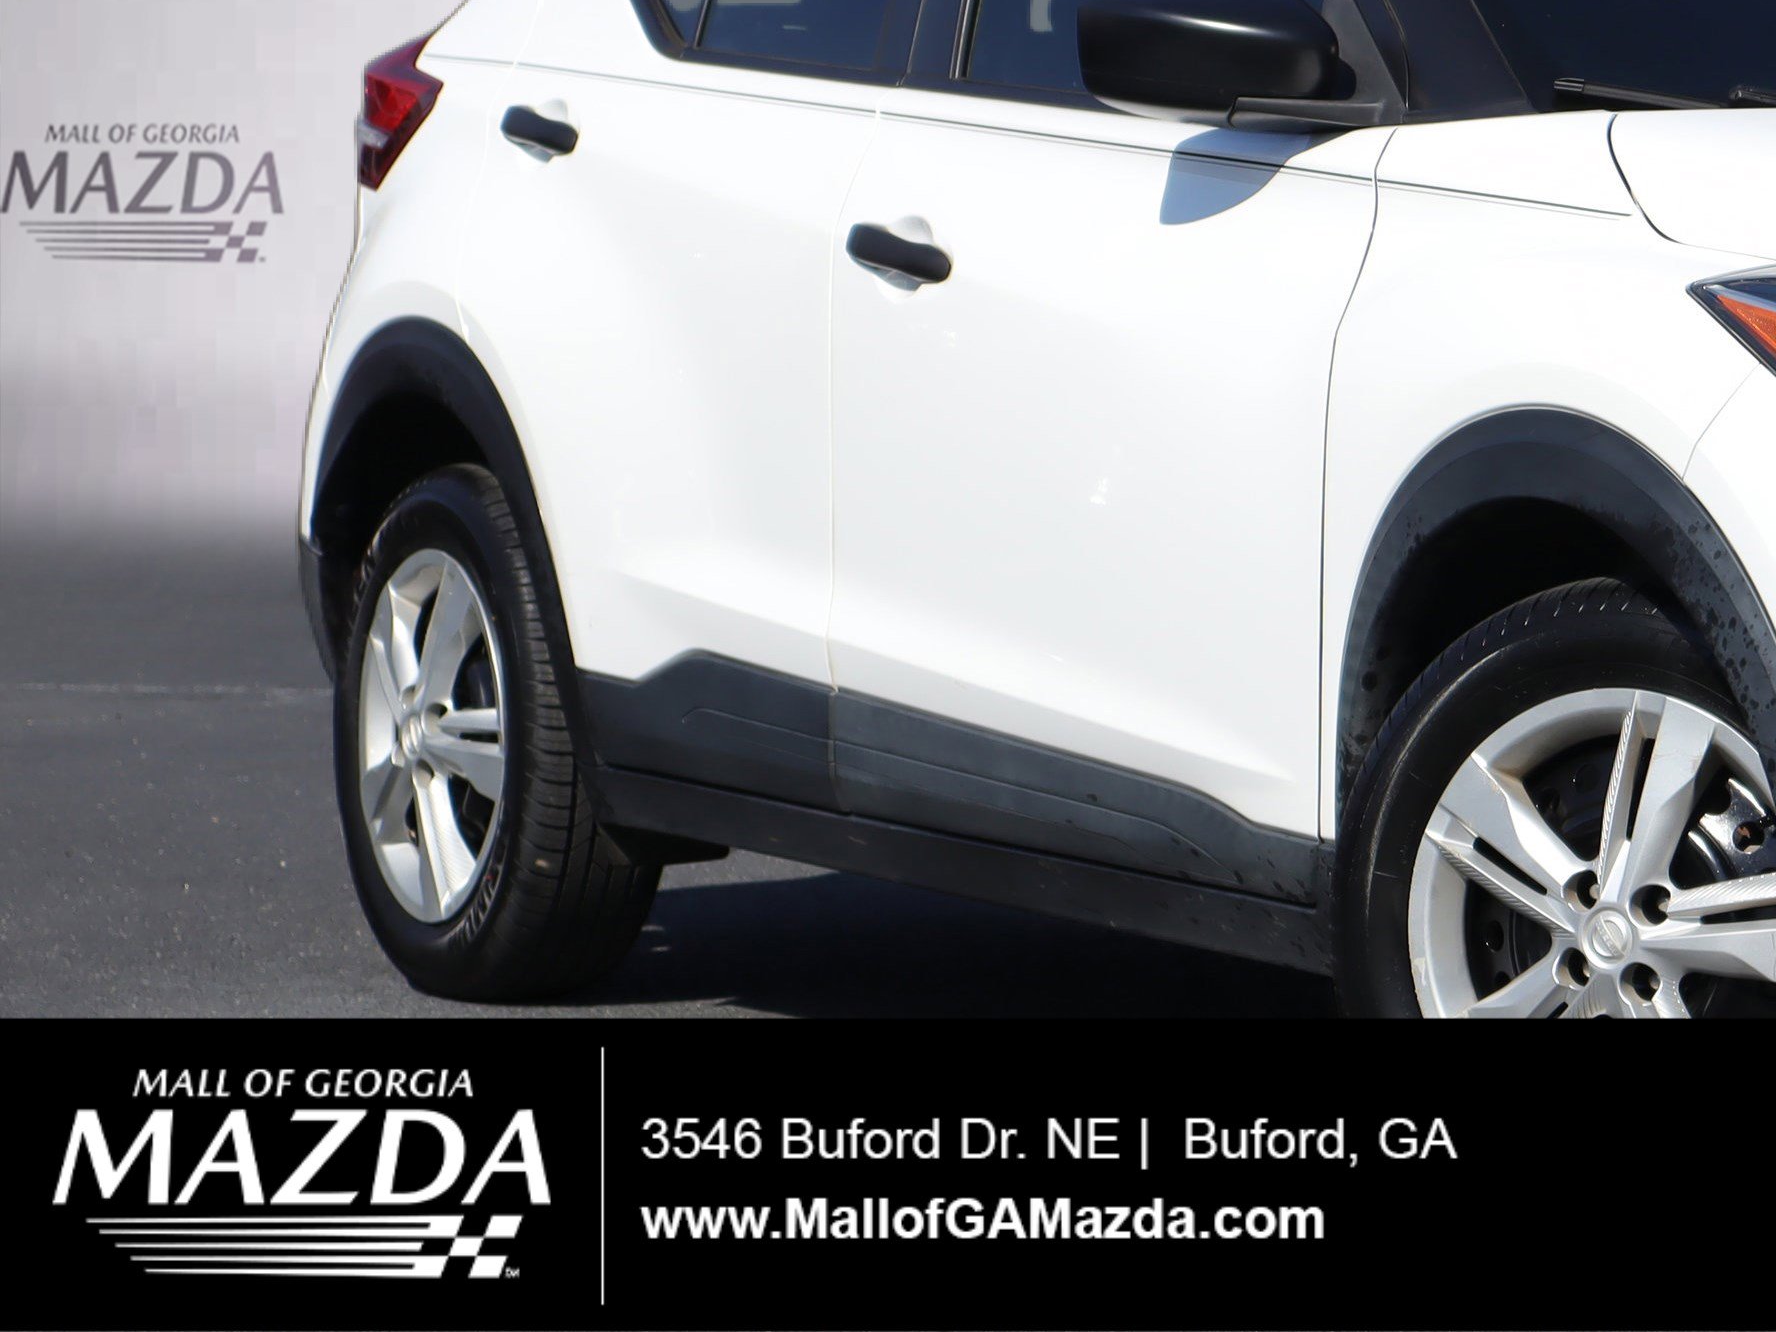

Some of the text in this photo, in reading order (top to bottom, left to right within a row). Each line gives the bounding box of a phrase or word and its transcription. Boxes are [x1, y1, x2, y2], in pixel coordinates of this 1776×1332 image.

[45, 123, 240, 144] MALL OF GEORGIA
[0, 150, 284, 215] MAZDA
